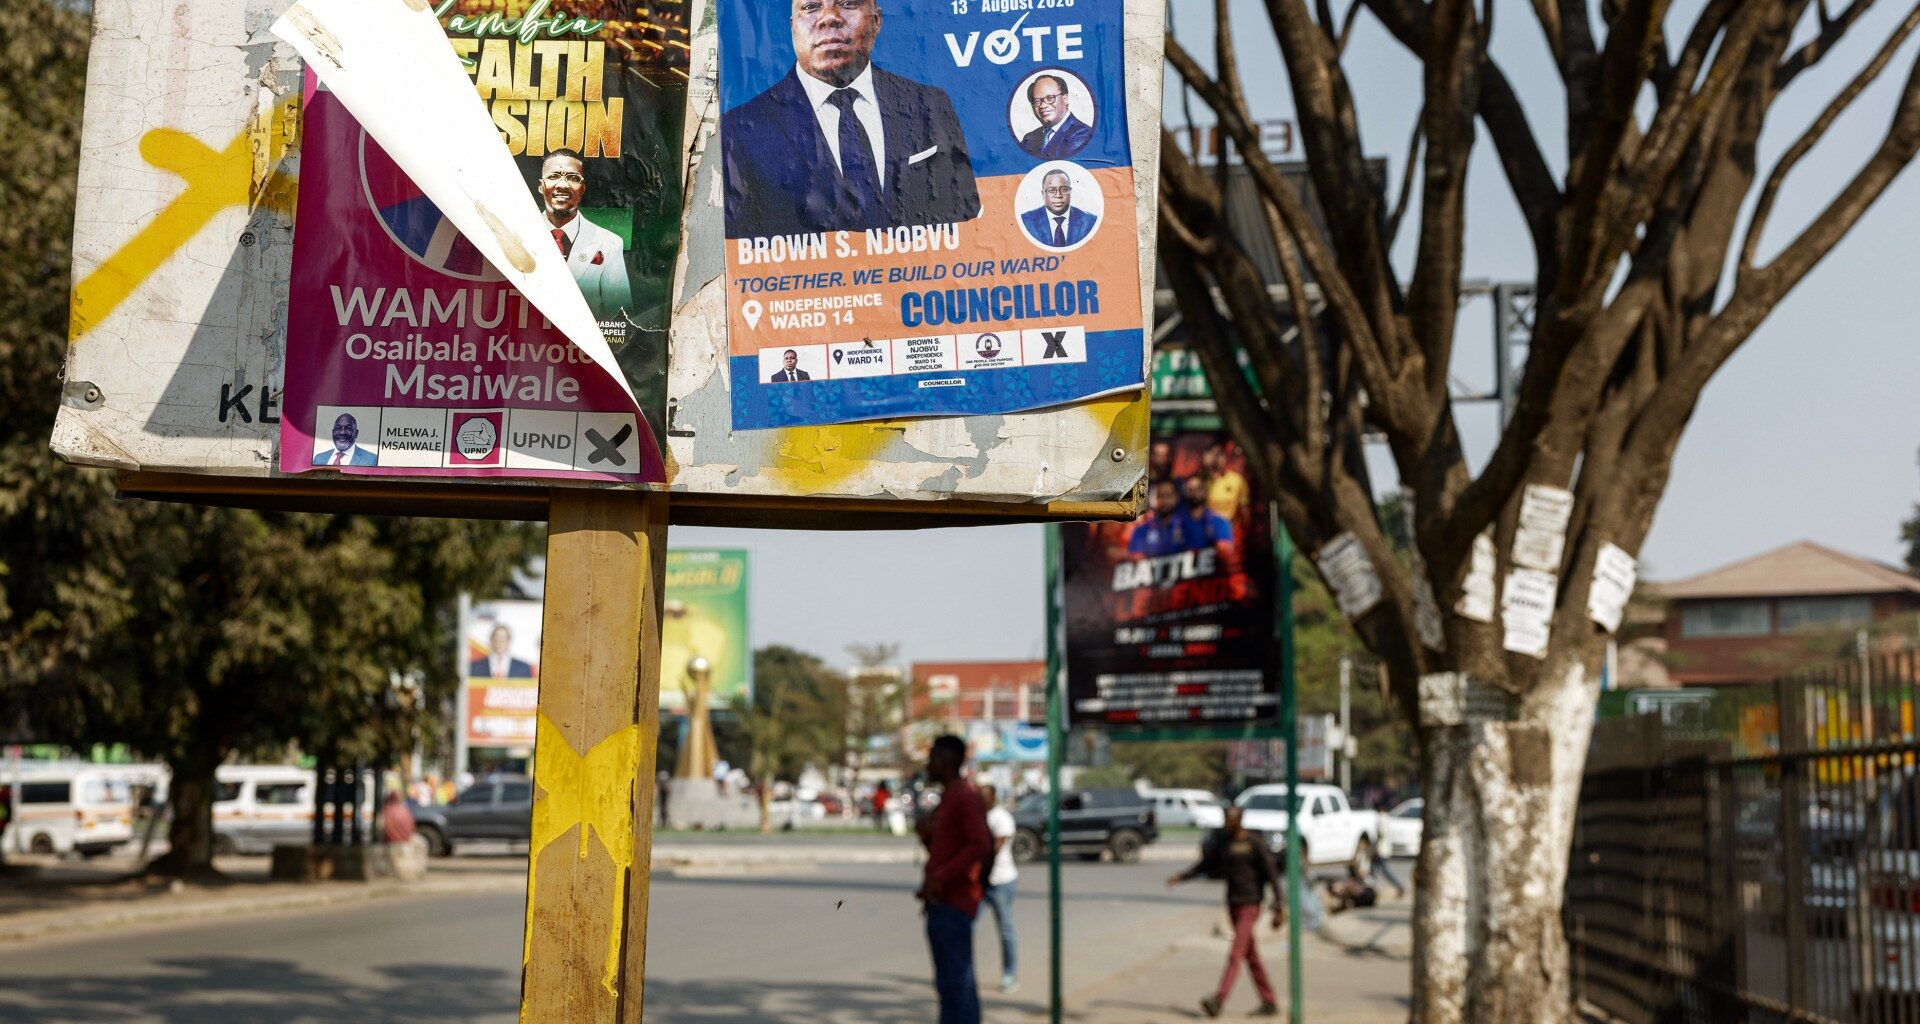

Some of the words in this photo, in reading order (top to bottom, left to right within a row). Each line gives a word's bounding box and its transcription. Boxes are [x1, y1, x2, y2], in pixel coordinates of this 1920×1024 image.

[436, 0, 602, 44] ambia
[944, 22, 1083, 67] VOTE
[487, 96, 624, 158] SION
[737, 231, 827, 265] BROWN
[835, 229, 858, 258] S.
[865, 222, 960, 255] NJOBVU
[853, 268, 884, 285] WE
[888, 264, 947, 283] BUILD
[952, 260, 995, 278] OUR
[330, 285, 552, 330] WAMUT
[769, 293, 883, 313] INDEPENDENCE
[900, 279, 1100, 328] COUNCILLOR
[770, 312, 827, 330] WARD
[832, 309, 855, 326] 14
[345, 333, 481, 362] Osaibala
[847, 348, 882, 356] INDEPENDENCE
[907, 338, 933, 346] BROWN
[910, 345, 939, 353] NJOBVU
[847, 356, 872, 365] WARD
[873, 355, 884, 363] 14
[908, 363, 943, 371] COUNCILOR
[384, 363, 580, 402] Msaiwale
[386, 427, 428, 438] MLEWA
[429, 428, 438, 438] J.
[513, 432, 572, 450] UPND
[381, 441, 441, 451] MSAIWALE
[464, 447, 488, 455] UPND
[1112, 547, 1217, 592] BATTLE
